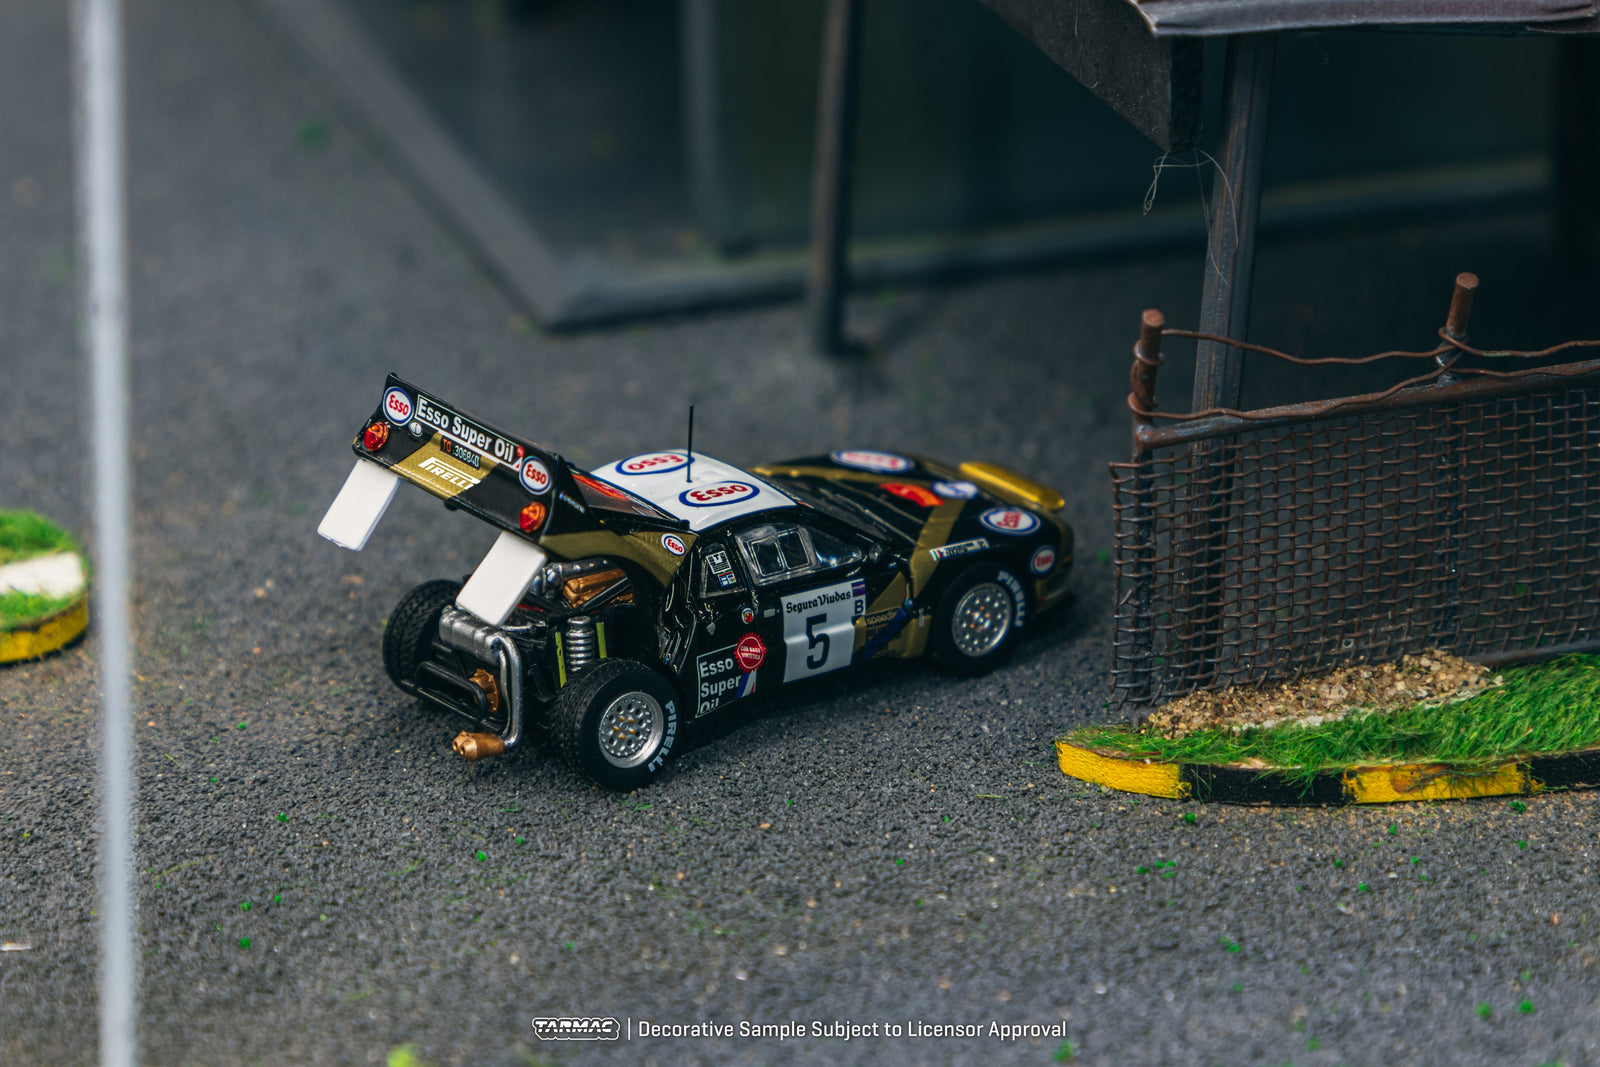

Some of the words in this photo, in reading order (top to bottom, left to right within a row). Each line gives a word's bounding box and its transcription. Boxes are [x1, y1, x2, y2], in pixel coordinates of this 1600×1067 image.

[388, 394, 409, 416] Esso
[417, 397, 449, 429] Esso
[452, 416, 492, 450] Super
[494, 438, 514, 462] Oil
[418, 457, 481, 490] PIRELLI
[525, 463, 547, 485] Esso
[690, 484, 748, 502] Esso
[666, 538, 683, 554] Esso
[786, 598, 818, 614] Segura
[817, 590, 851, 606] Viudas
[854, 599, 864, 615] B
[805, 612, 831, 670] 5
[699, 658, 734, 678] Esso
[700, 675, 742, 698] Super
[700, 698, 720, 715] Oil
[648, 700, 677, 772] PIRELLI
